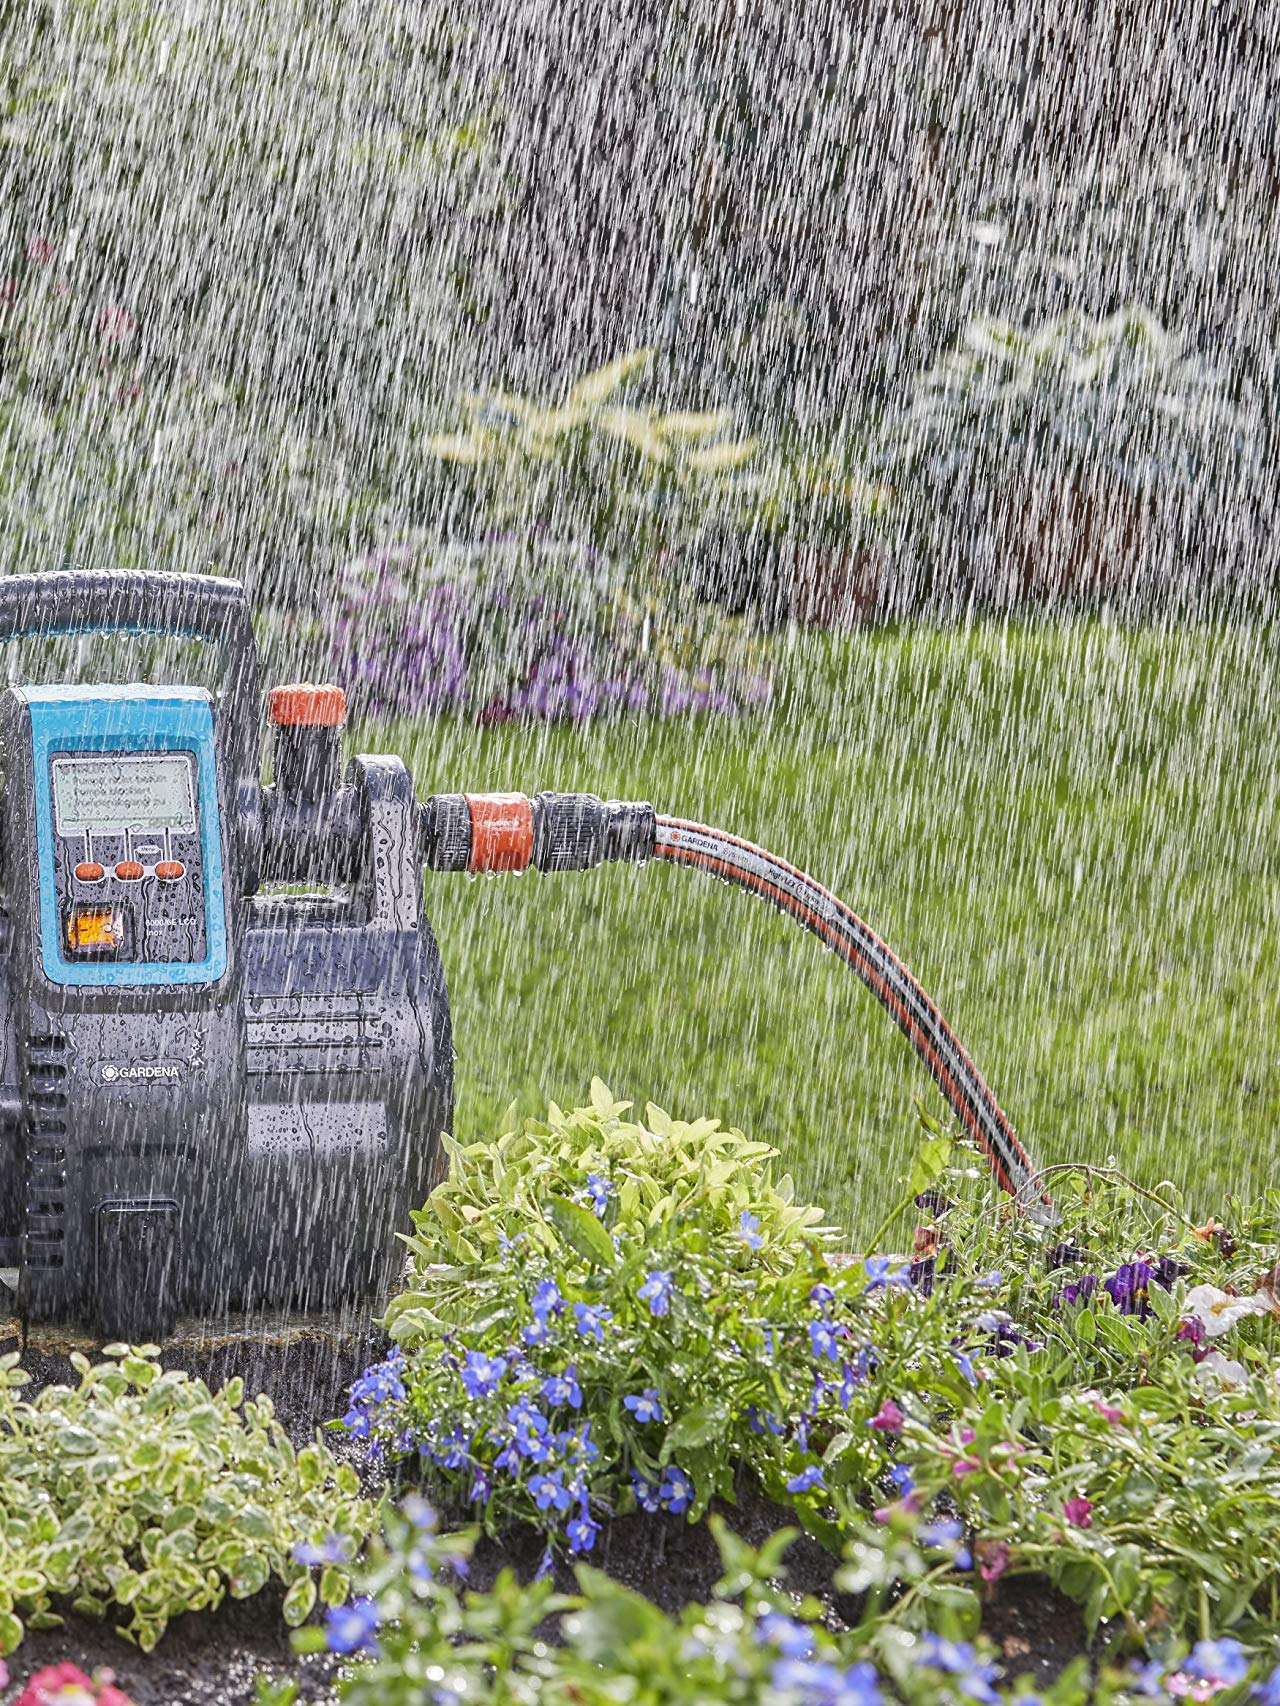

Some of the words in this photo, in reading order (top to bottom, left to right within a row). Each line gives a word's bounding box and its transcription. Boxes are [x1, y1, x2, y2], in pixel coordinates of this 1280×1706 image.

[681, 834, 718, 852] GARDENA
[179, 918, 196, 926] LCD
[119, 1066, 179, 1078] GARDENA
